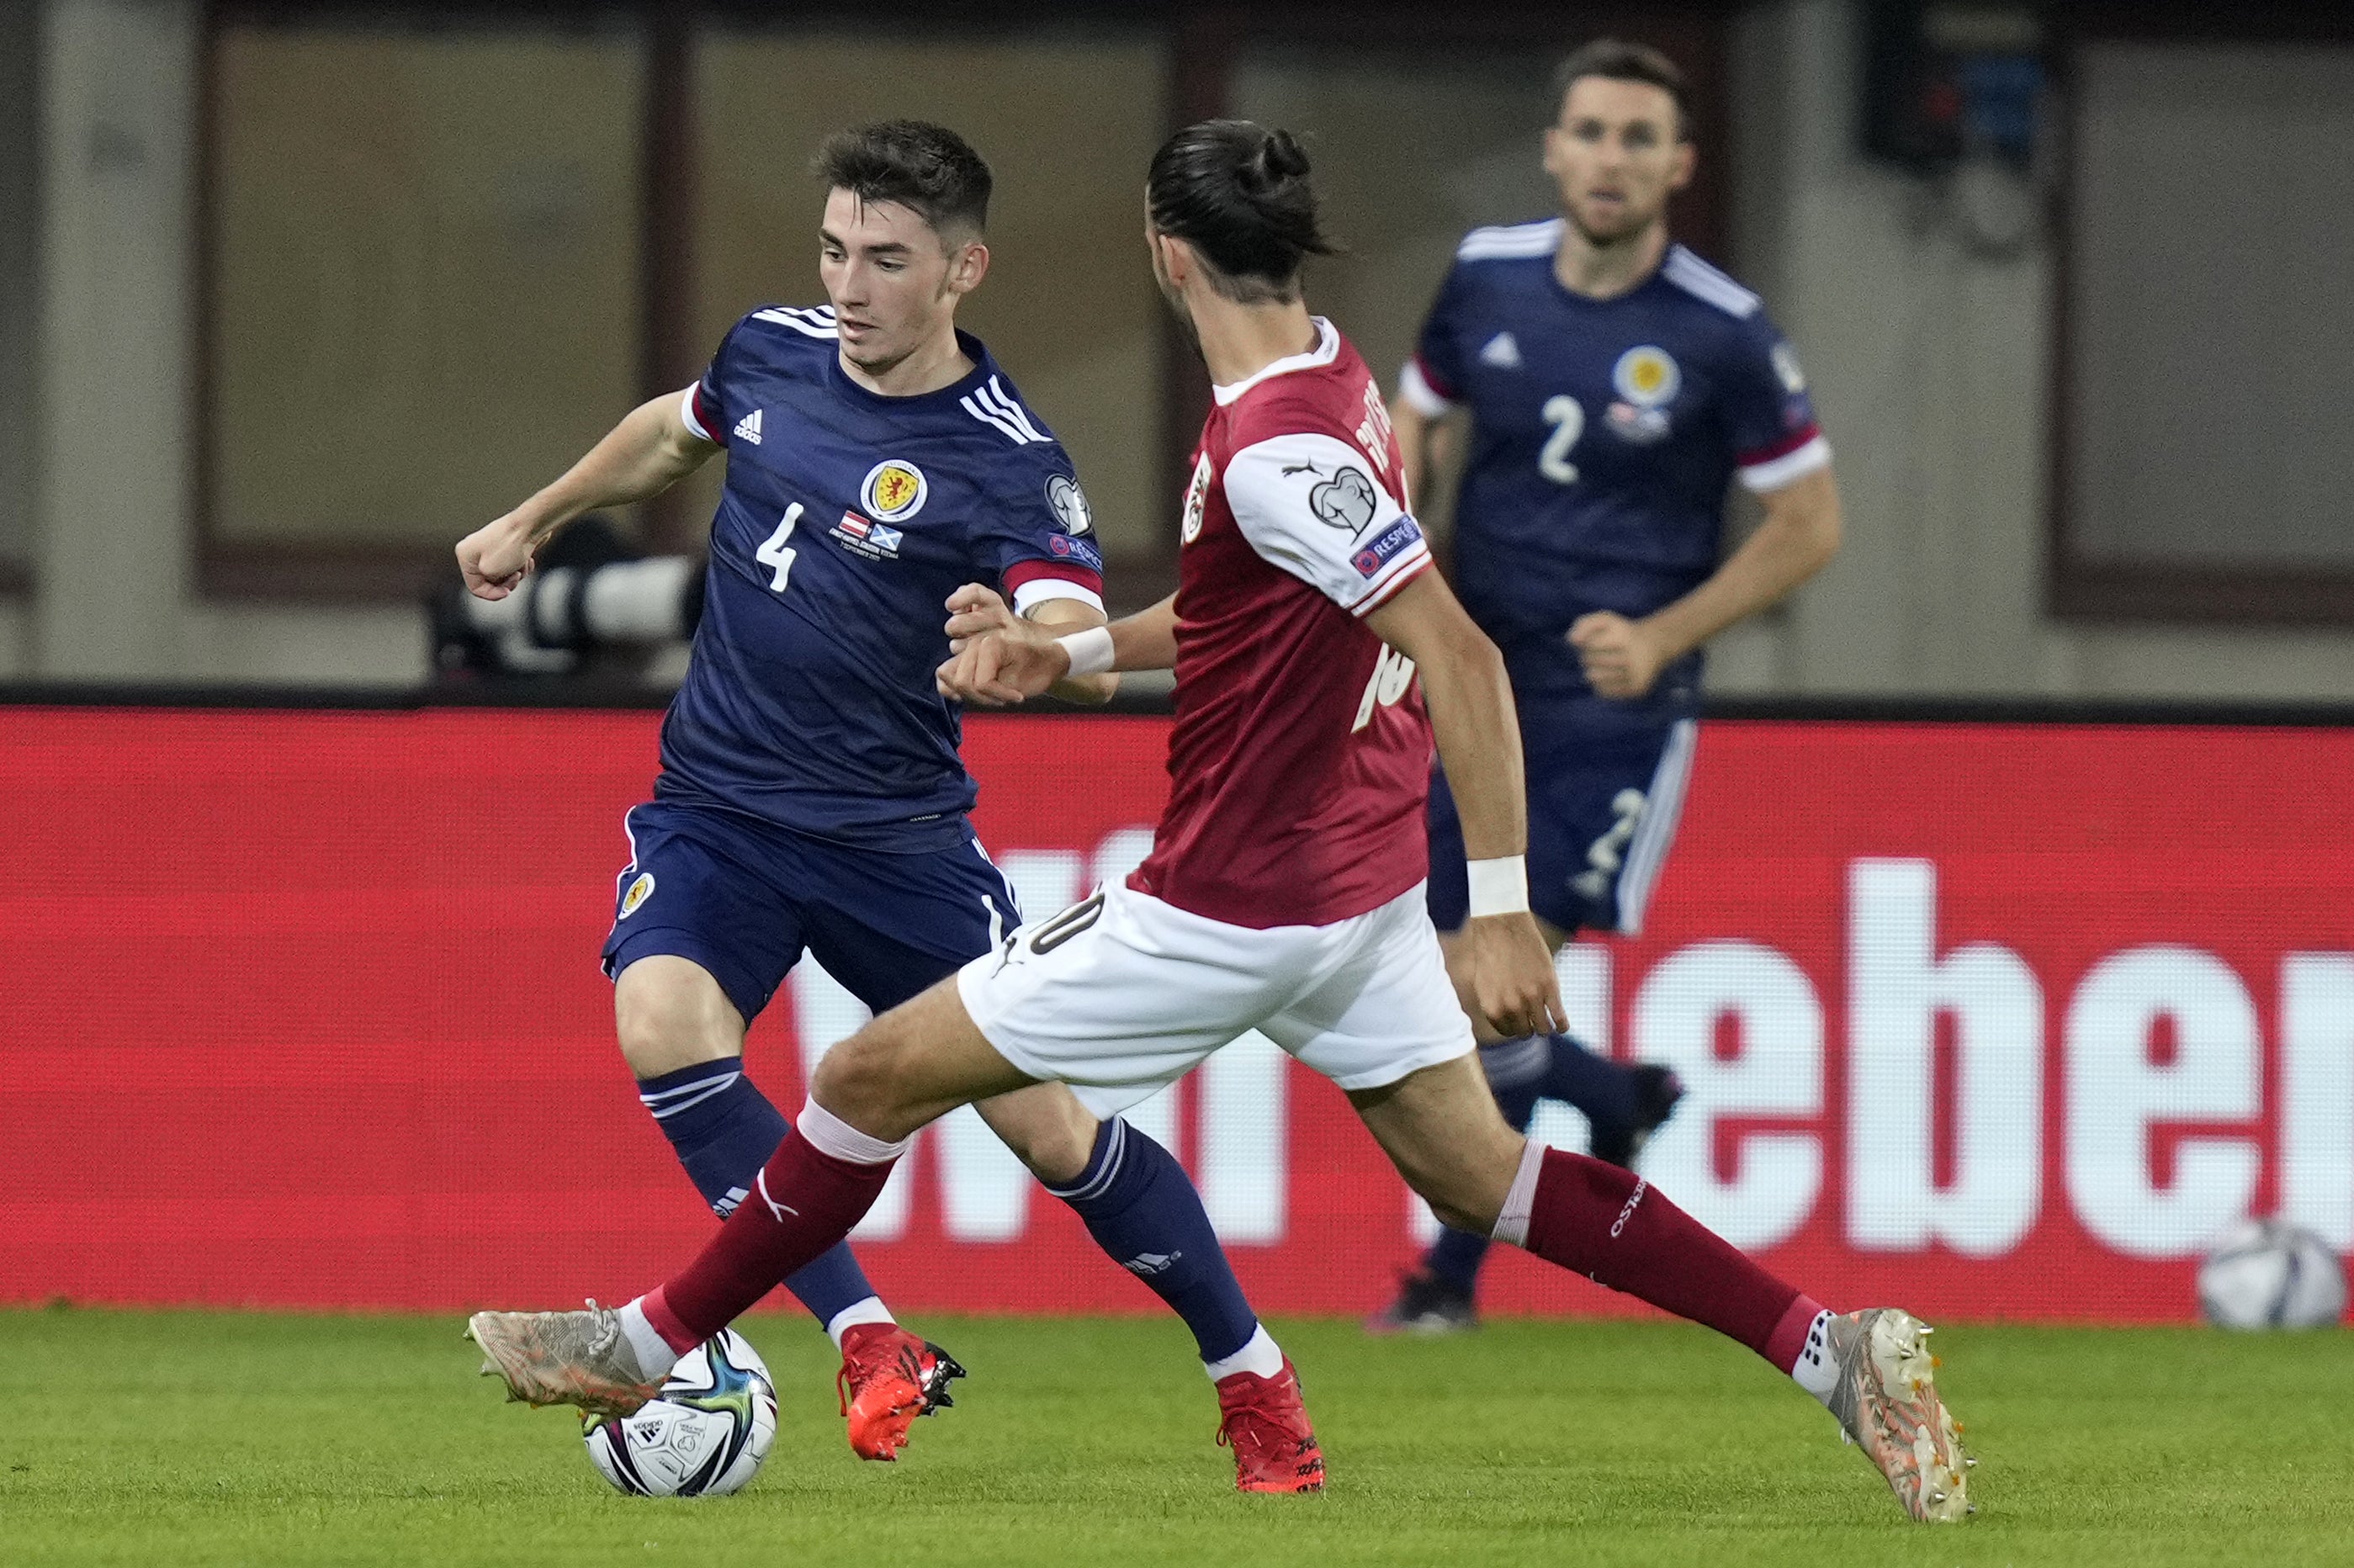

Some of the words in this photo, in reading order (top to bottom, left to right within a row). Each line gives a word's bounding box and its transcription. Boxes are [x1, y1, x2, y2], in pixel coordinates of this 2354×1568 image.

[734, 425, 762, 445] adidas
[1540, 394, 1586, 485] 2
[756, 501, 804, 592] 4
[1568, 787, 1646, 898] 2
[634, 1419, 664, 1430] adidas
